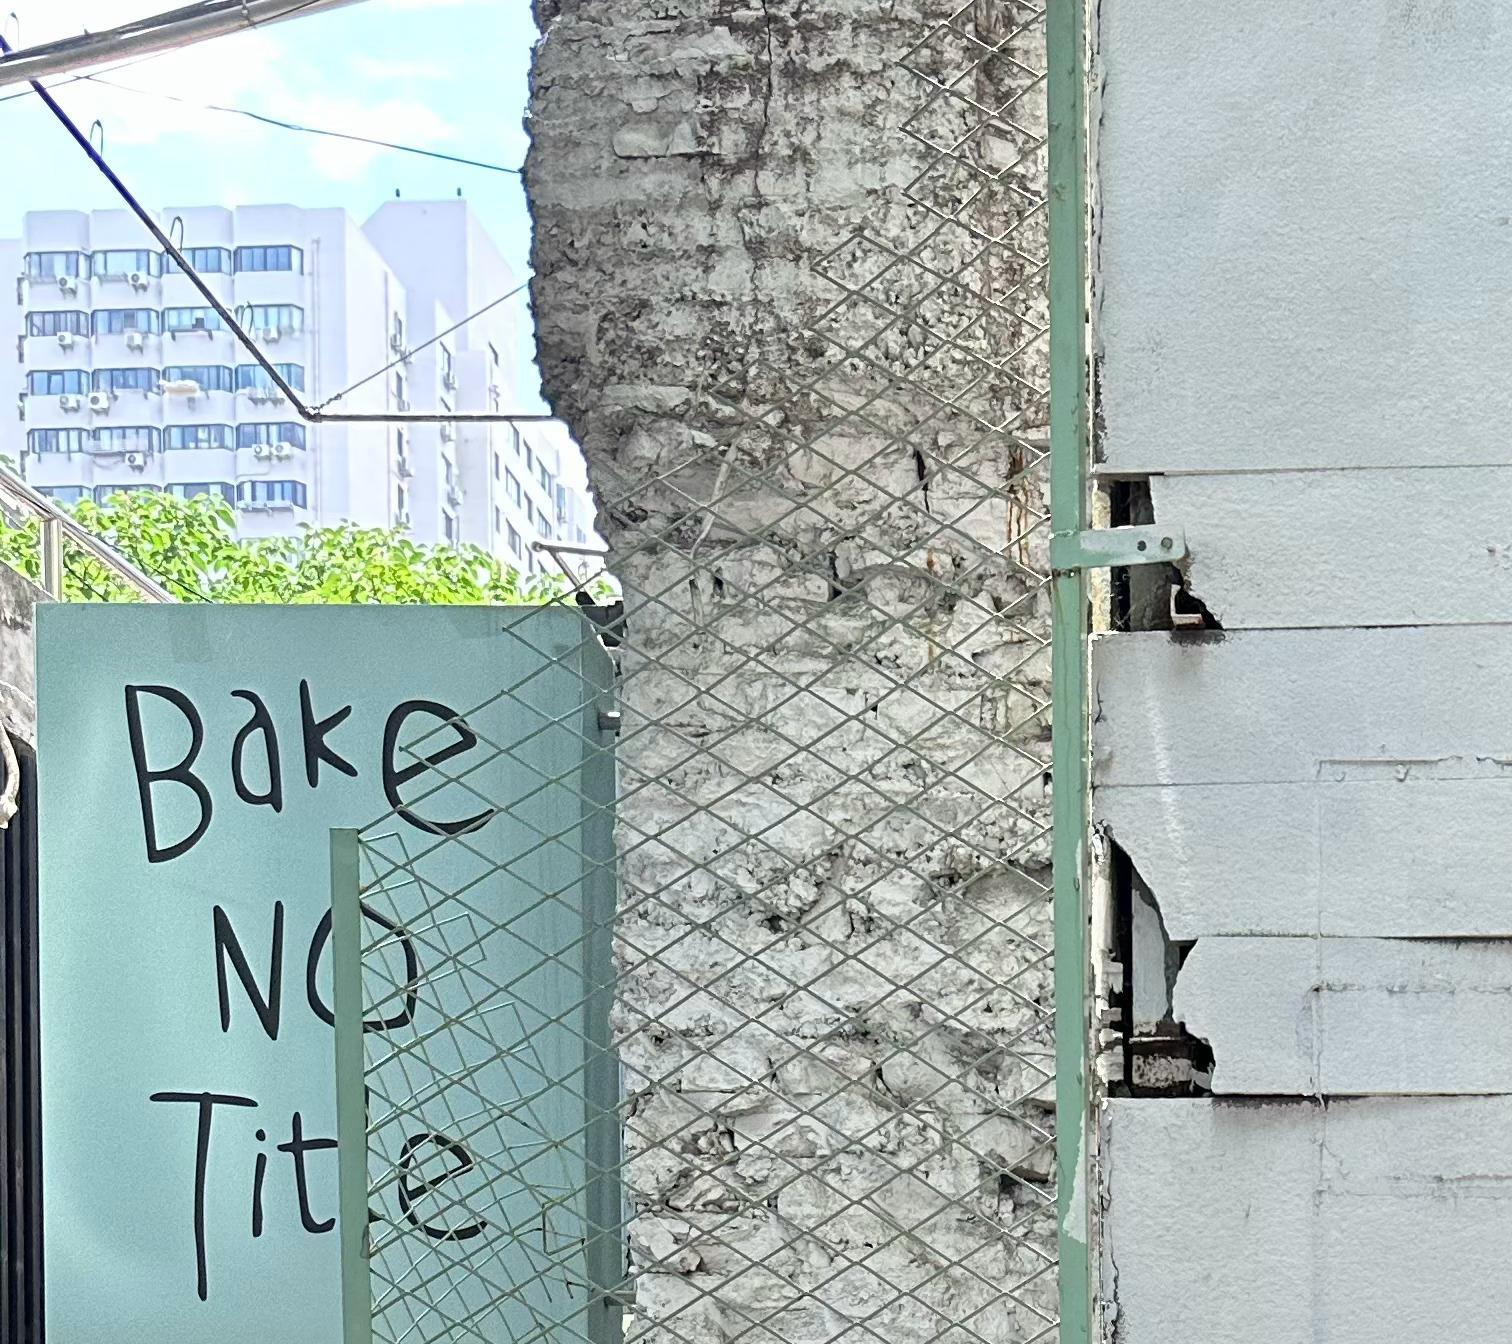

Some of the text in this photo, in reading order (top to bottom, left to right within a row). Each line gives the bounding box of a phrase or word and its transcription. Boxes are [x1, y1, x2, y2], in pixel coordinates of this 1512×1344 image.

[125, 679, 496, 863] Bake
[213, 900, 418, 1041] NO
[149, 1085, 488, 1302] Tite
